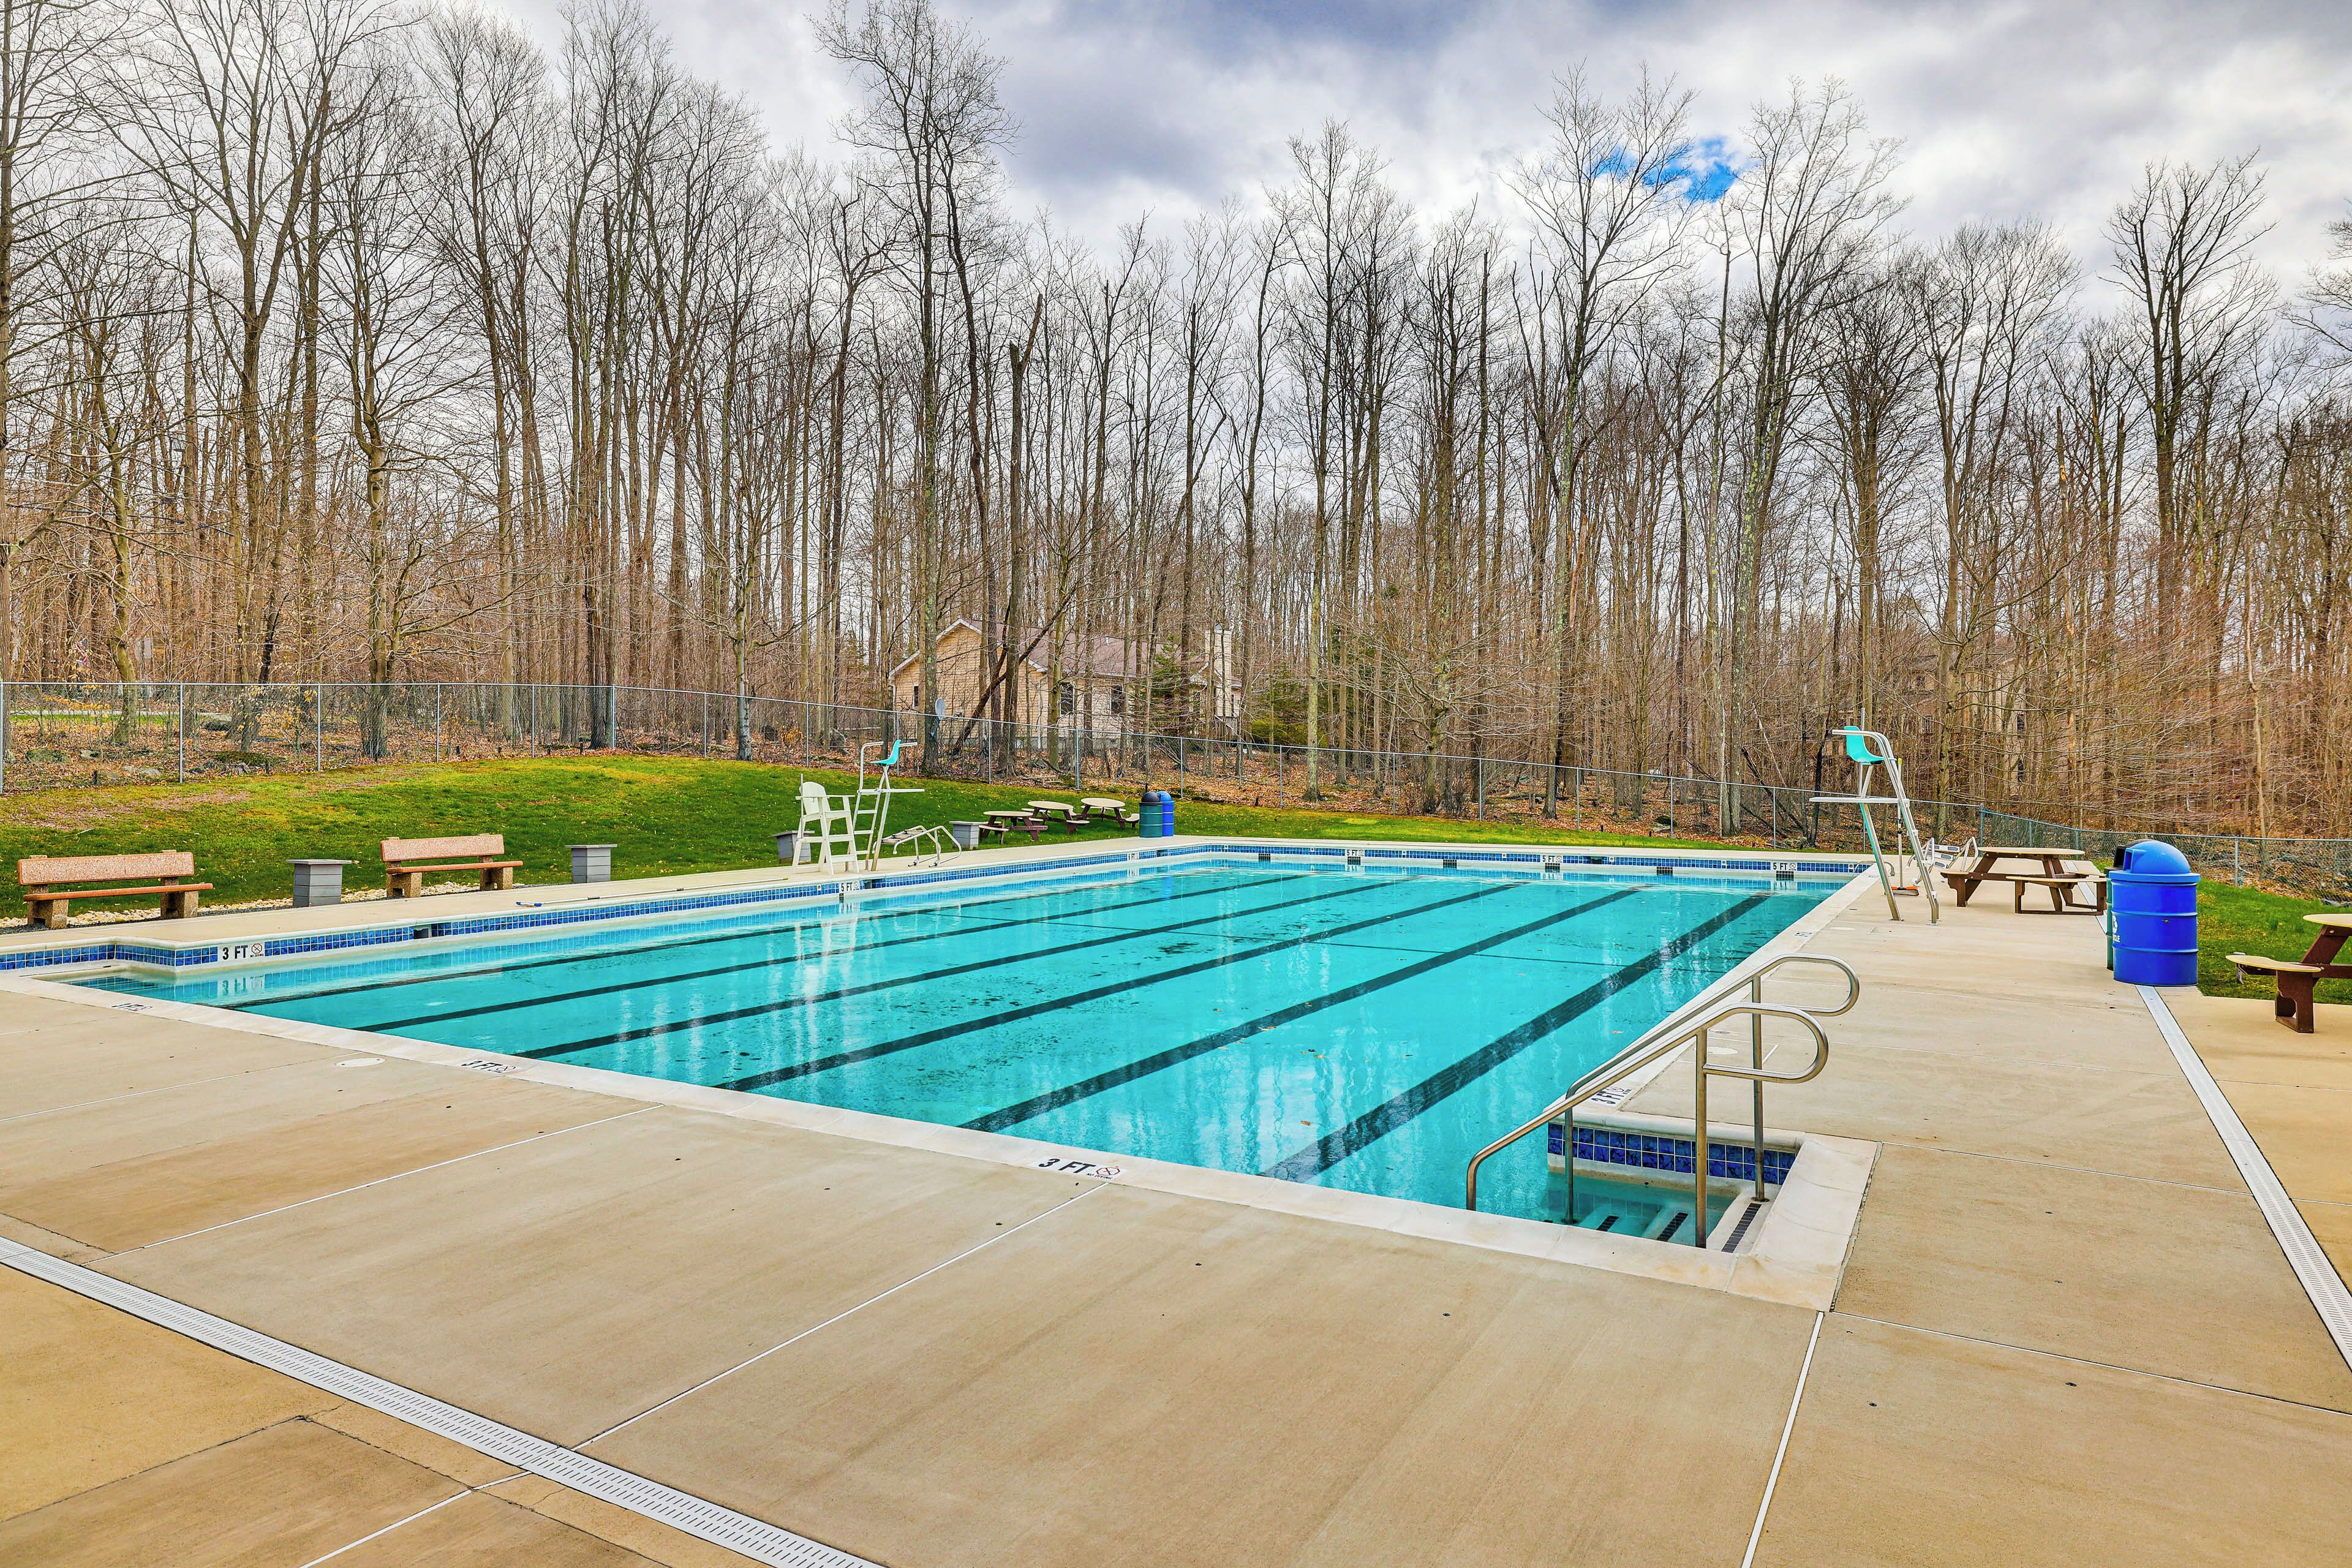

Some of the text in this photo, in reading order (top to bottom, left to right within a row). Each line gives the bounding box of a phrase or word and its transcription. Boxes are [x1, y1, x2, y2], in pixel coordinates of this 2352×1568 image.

[841, 882, 852, 892] 5 FT
[222, 945, 248, 960] 3 FT
[1038, 1158, 1096, 1174] 3 FT
